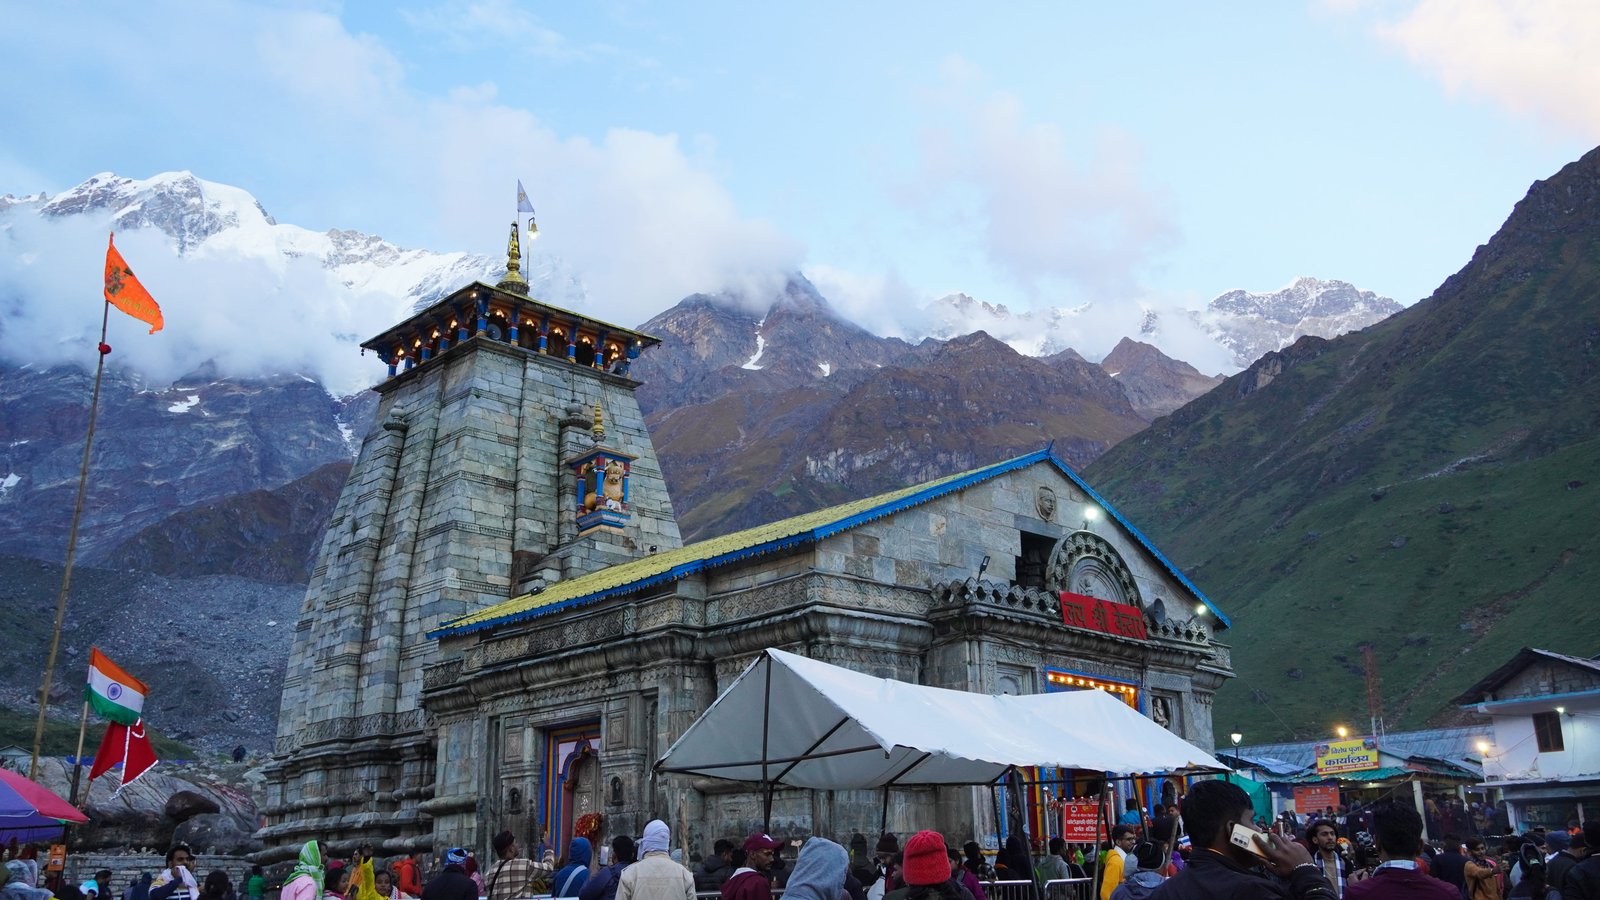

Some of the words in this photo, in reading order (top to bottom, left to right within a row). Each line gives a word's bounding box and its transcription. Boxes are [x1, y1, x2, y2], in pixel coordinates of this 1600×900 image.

[1064, 601, 1087, 627] जय
[1093, 600, 1109, 633] श्री
[1112, 602, 1147, 640] केदार
[1348, 745, 1362, 755] पूजा
[1325, 755, 1369, 766] कार्यालय
